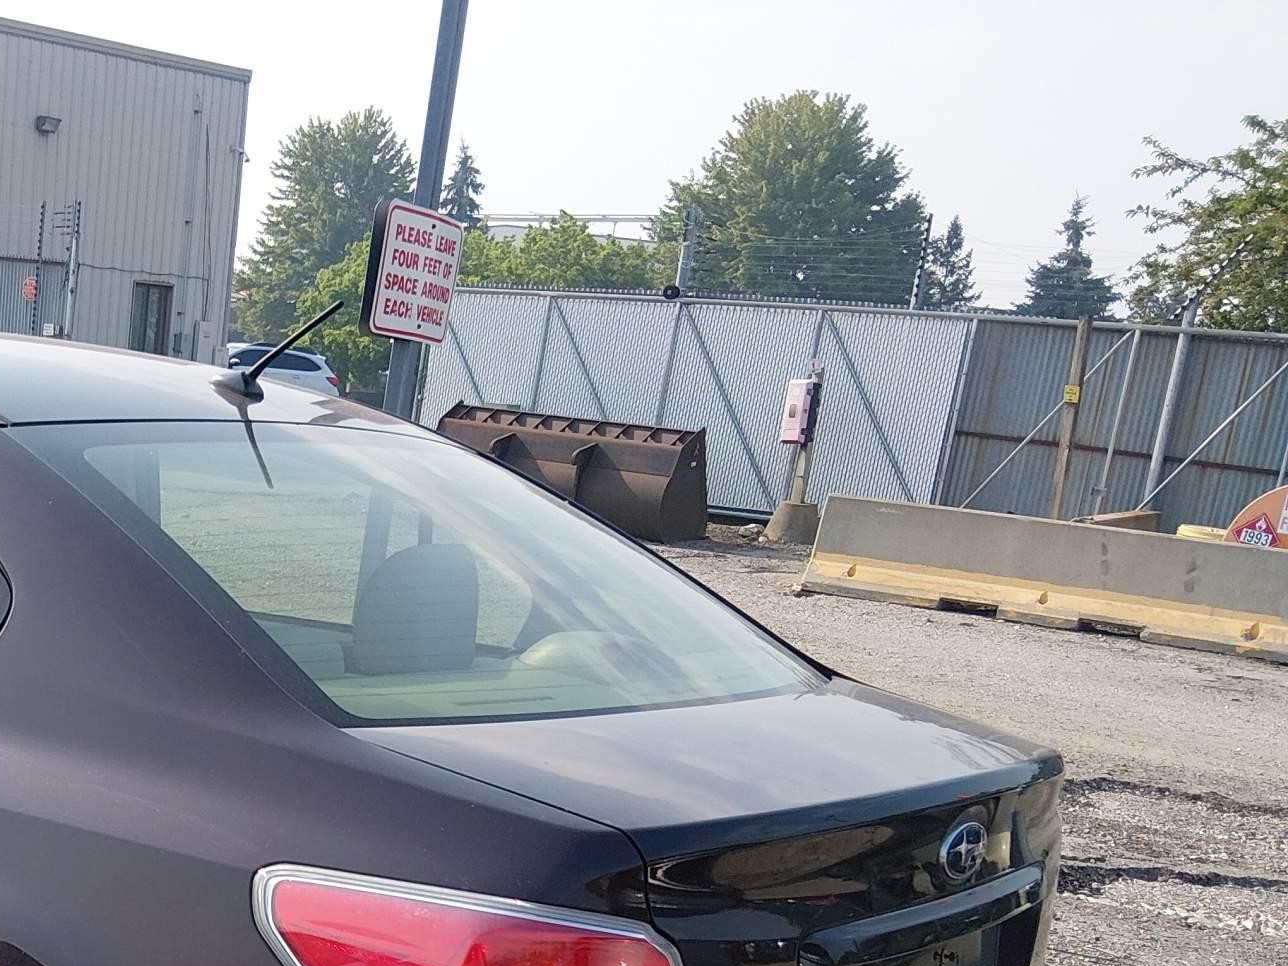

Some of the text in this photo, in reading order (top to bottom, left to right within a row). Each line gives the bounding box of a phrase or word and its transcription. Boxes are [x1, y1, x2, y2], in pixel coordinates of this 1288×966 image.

[395, 223, 456, 257] PLEASE LEAVE
[392, 248, 453, 279] FOUR FEET OF
[384, 272, 450, 304] SPACE AROUND
[383, 297, 444, 327] EACH VEHICLE
[1243, 530, 1270, 546] 1993
